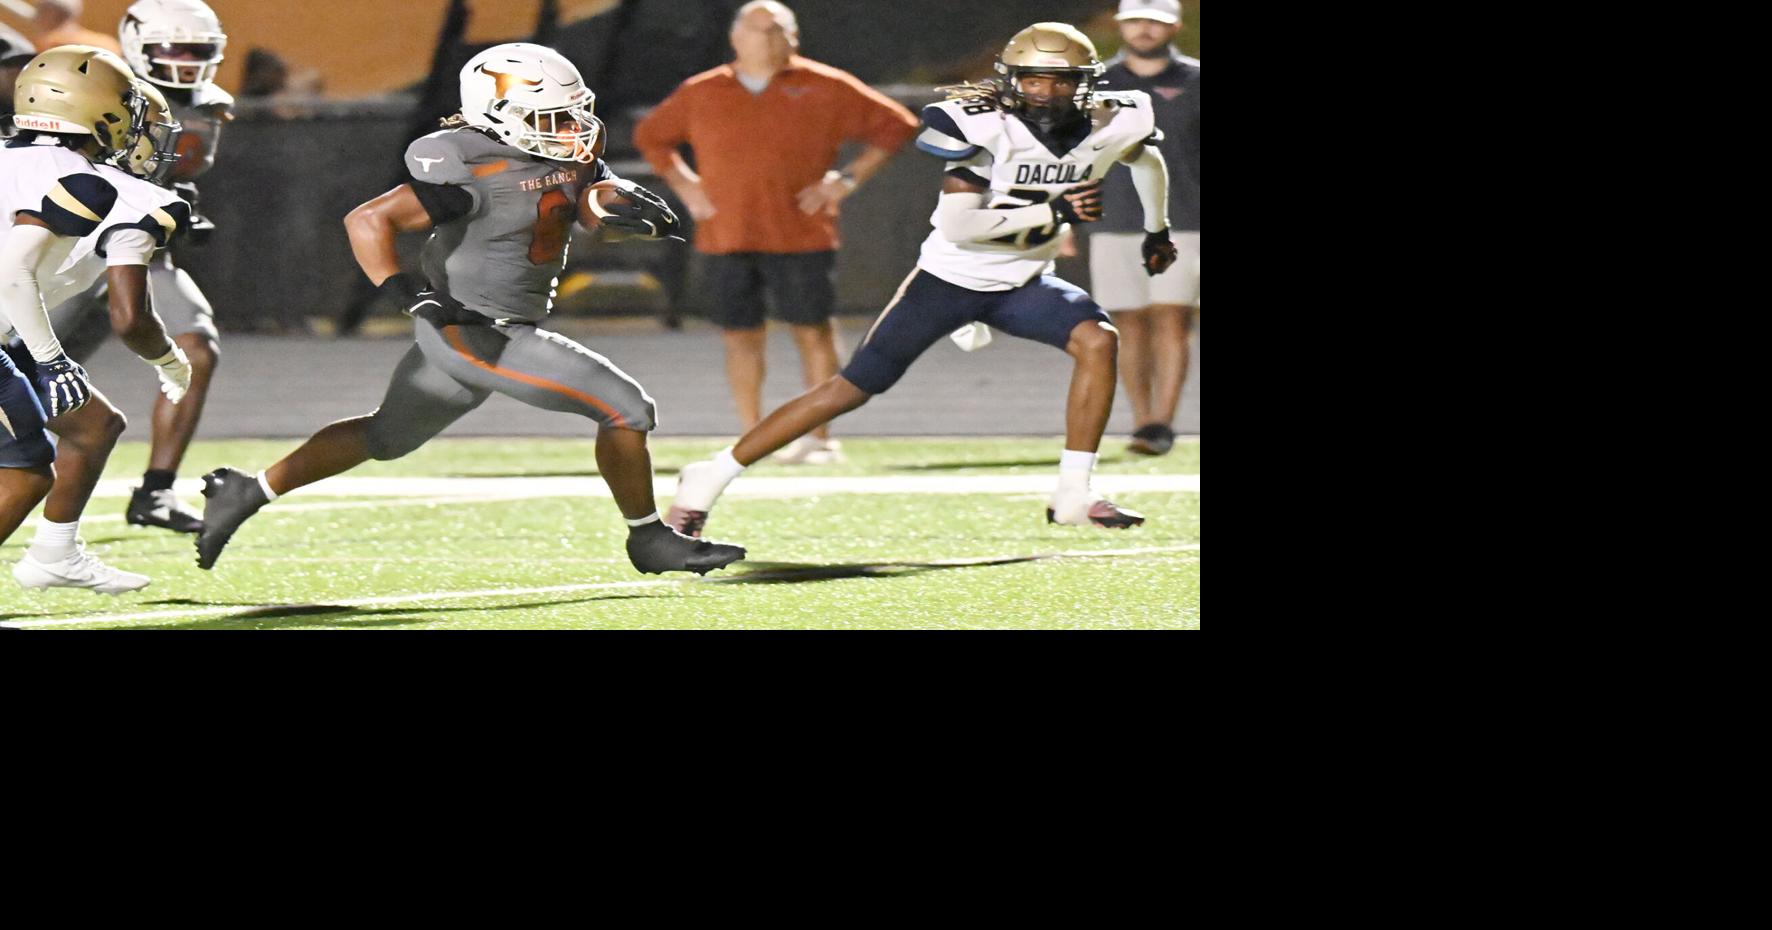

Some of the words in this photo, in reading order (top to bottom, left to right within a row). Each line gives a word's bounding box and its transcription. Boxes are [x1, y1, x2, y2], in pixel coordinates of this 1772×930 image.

[519, 178, 542, 192] THE
[545, 169, 577, 187] RANCH
[1015, 163, 1093, 185] DACULA
